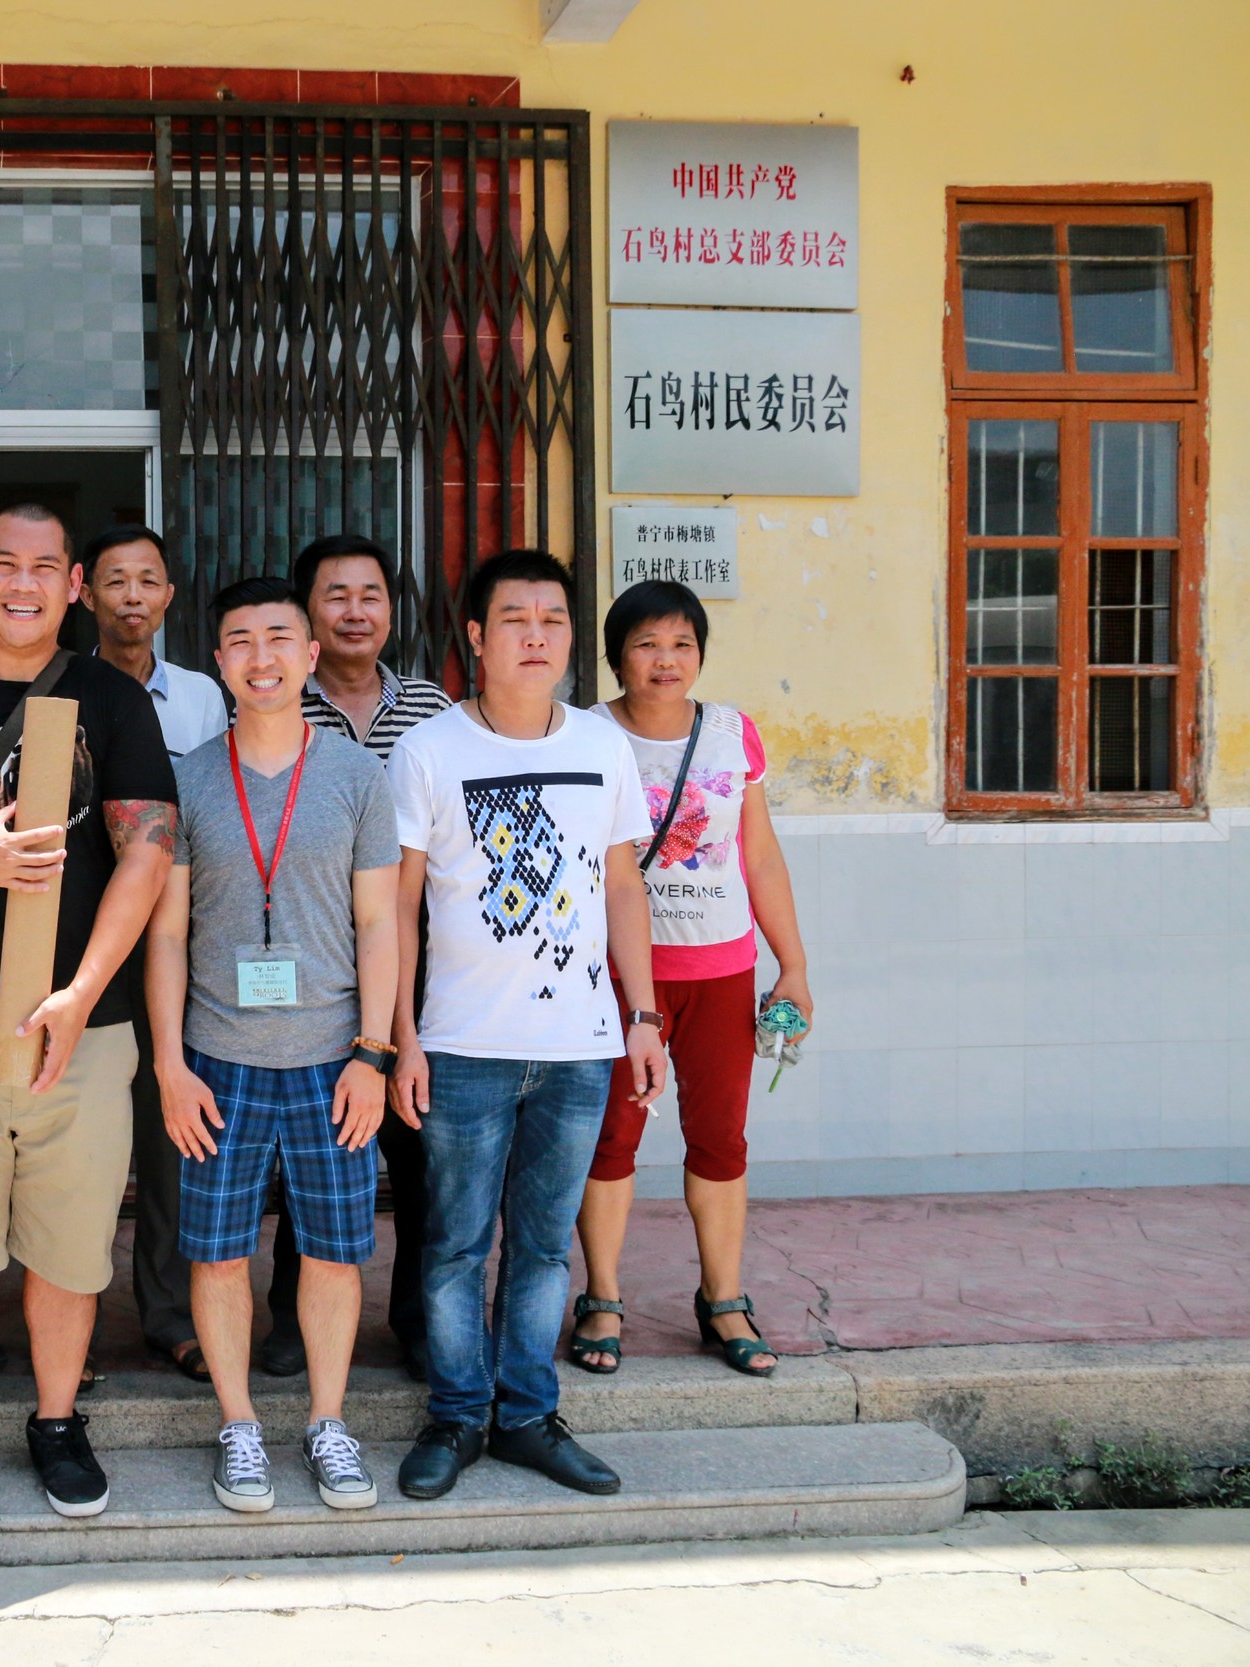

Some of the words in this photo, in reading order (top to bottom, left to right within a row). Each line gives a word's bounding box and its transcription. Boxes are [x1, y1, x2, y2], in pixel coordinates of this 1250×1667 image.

[672, 162, 797, 200] 中国共产党
[621, 226, 847, 268] 石鸟村总支部委员会
[624, 370, 849, 433] 石鸟村民委员会
[636, 525, 715, 543] 普宁市梅塘镇
[622, 558, 730, 583] 石鸟村代表工作室
[652, 909, 704, 919] LONDON
